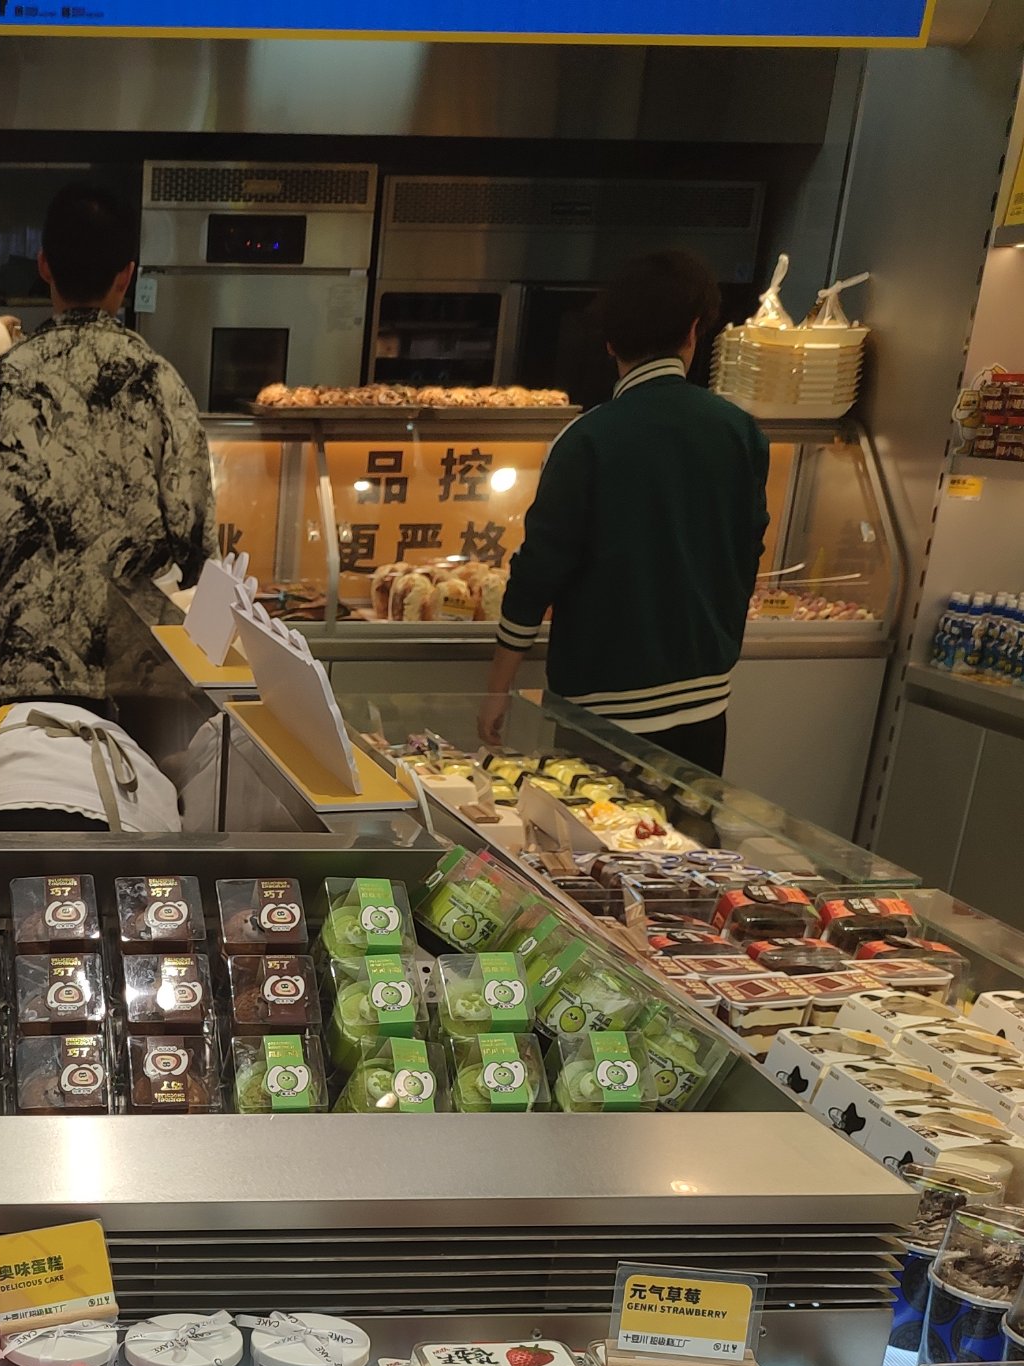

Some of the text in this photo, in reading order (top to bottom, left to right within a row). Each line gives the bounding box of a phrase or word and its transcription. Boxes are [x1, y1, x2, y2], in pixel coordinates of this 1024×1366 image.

[357, 448, 492, 504] 品控
[0, 1275, 65, 1292] DELICIOUS CAKE
[629, 1283, 702, 1305] 元气草莓
[626, 1302, 728, 1320] GENKI STRAWBERRY
[255, 1317, 281, 1329] CAKE
[14, 1329, 39, 1346] CAKE
[327, 1331, 355, 1346] CAKE
